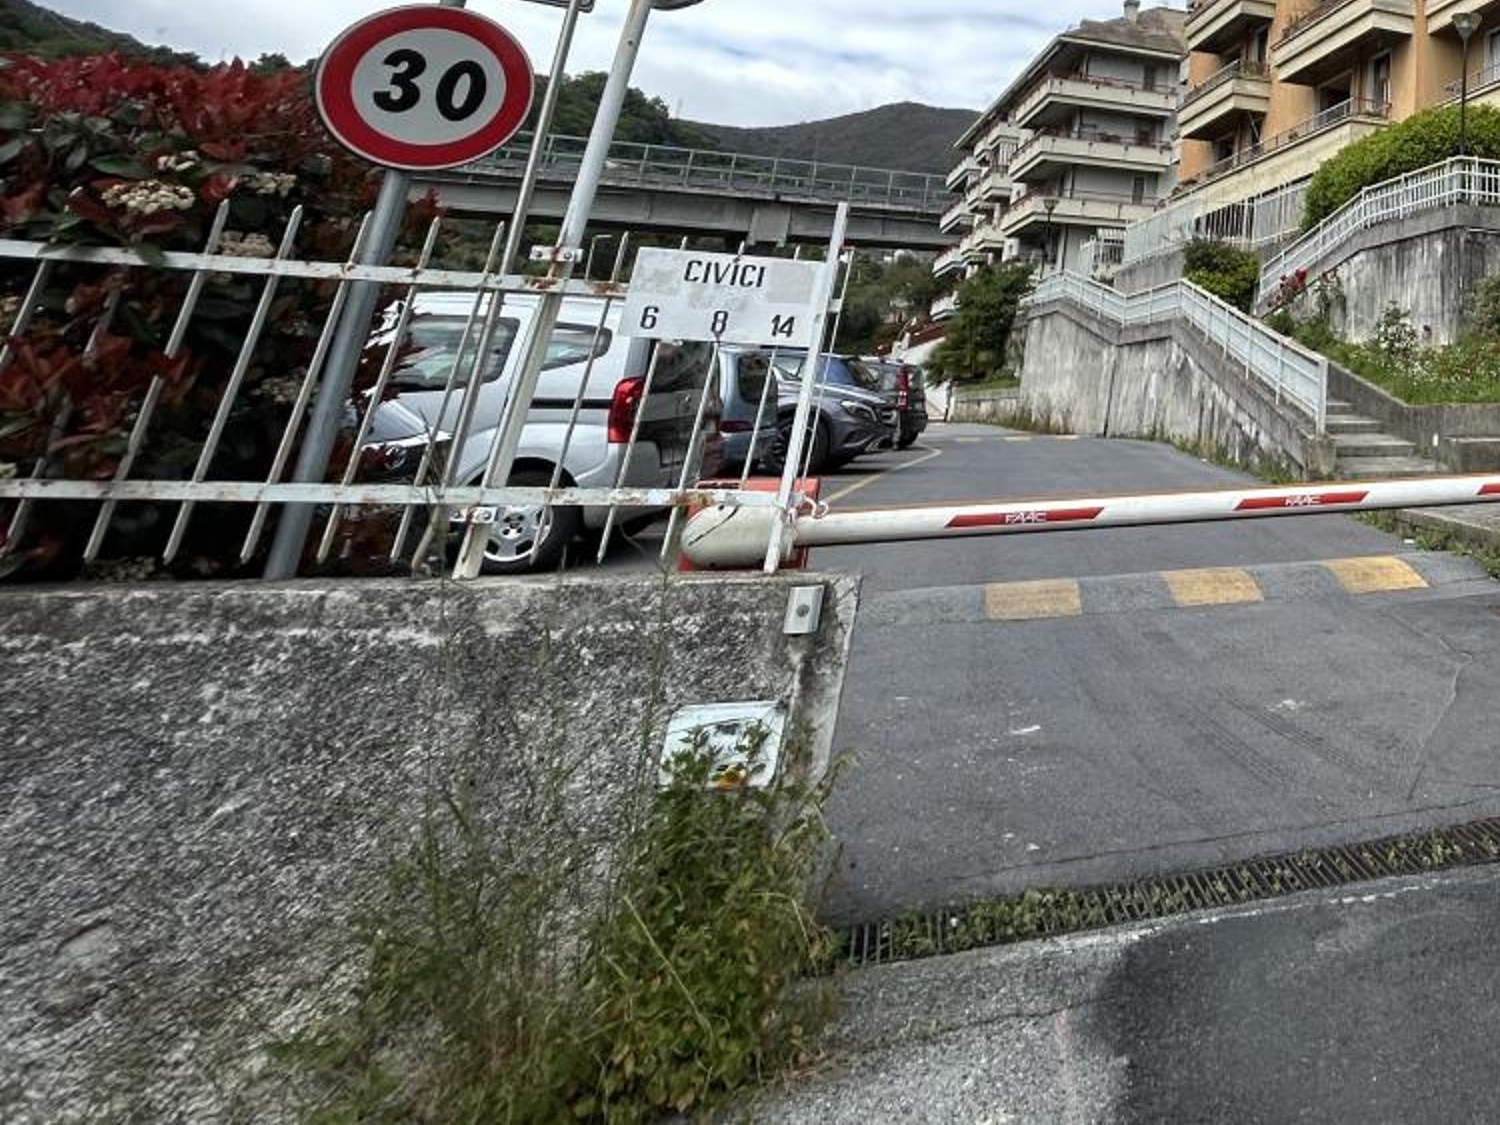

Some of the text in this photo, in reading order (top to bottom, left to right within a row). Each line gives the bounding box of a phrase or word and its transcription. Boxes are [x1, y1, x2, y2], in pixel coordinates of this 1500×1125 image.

[373, 48, 487, 122] 30
[684, 260, 767, 288] CIVICI
[640, 306, 795, 338] 6 8 14
